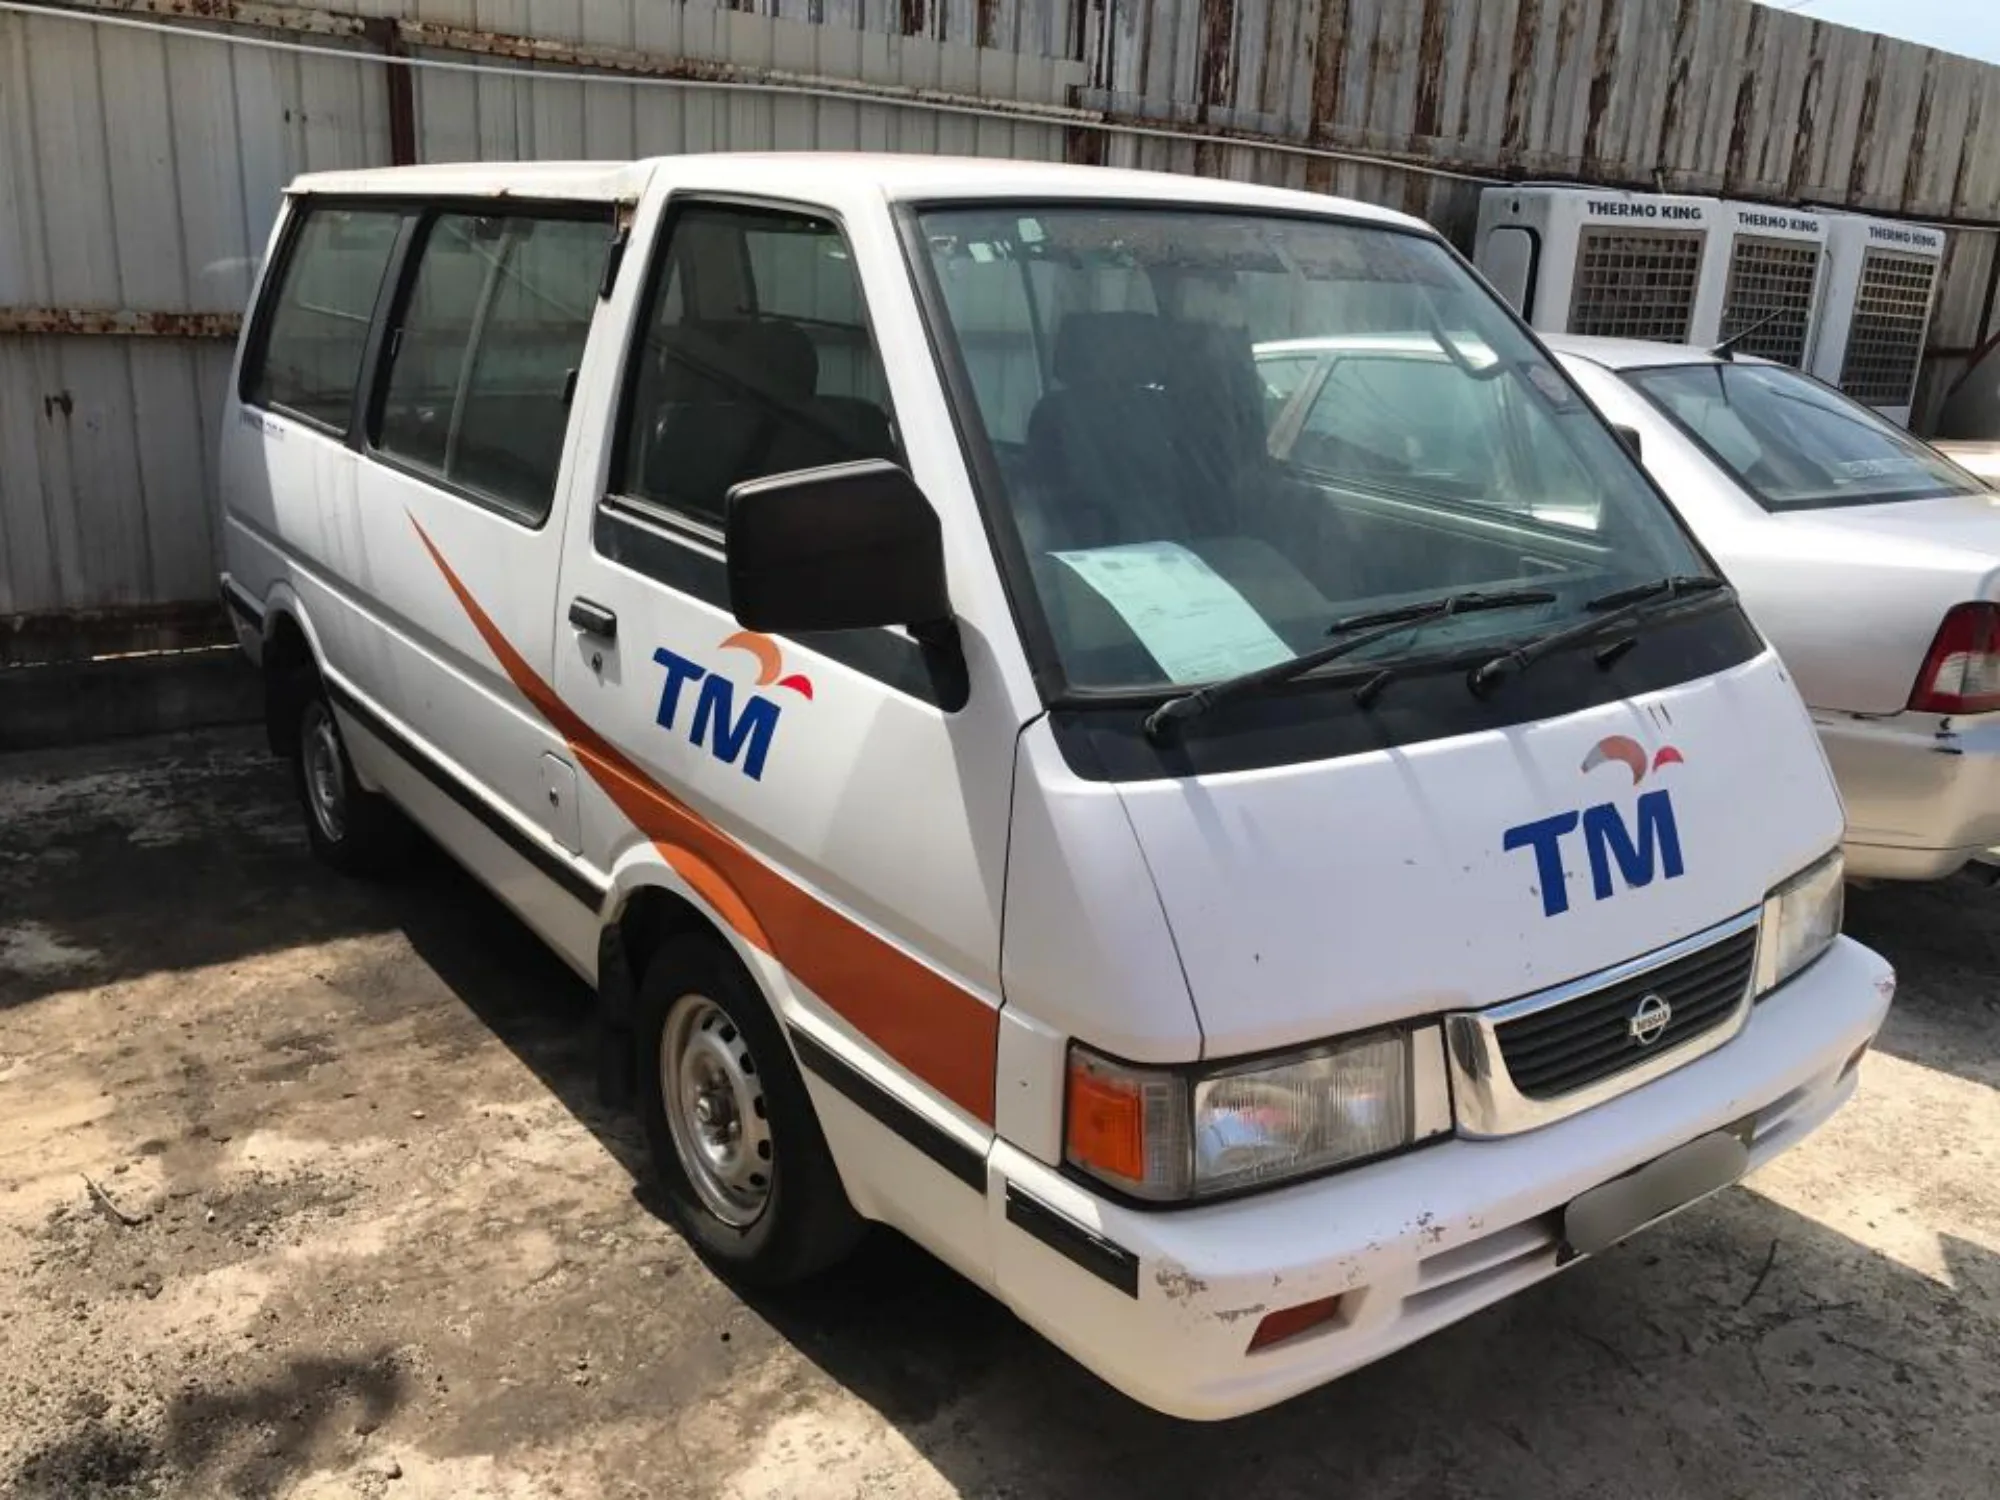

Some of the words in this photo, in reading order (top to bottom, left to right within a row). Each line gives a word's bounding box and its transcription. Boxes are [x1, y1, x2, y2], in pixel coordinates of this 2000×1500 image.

[1587, 200, 1657, 218] THERMO
[1661, 206, 1702, 220] KING
[1737, 212, 1788, 230] THERMO
[1790, 218, 1819, 233] KING
[1869, 226, 1911, 243] THERMO
[1912, 232, 1937, 247] KING
[652, 647, 781, 782] TM
[1503, 789, 1684, 917] TM
